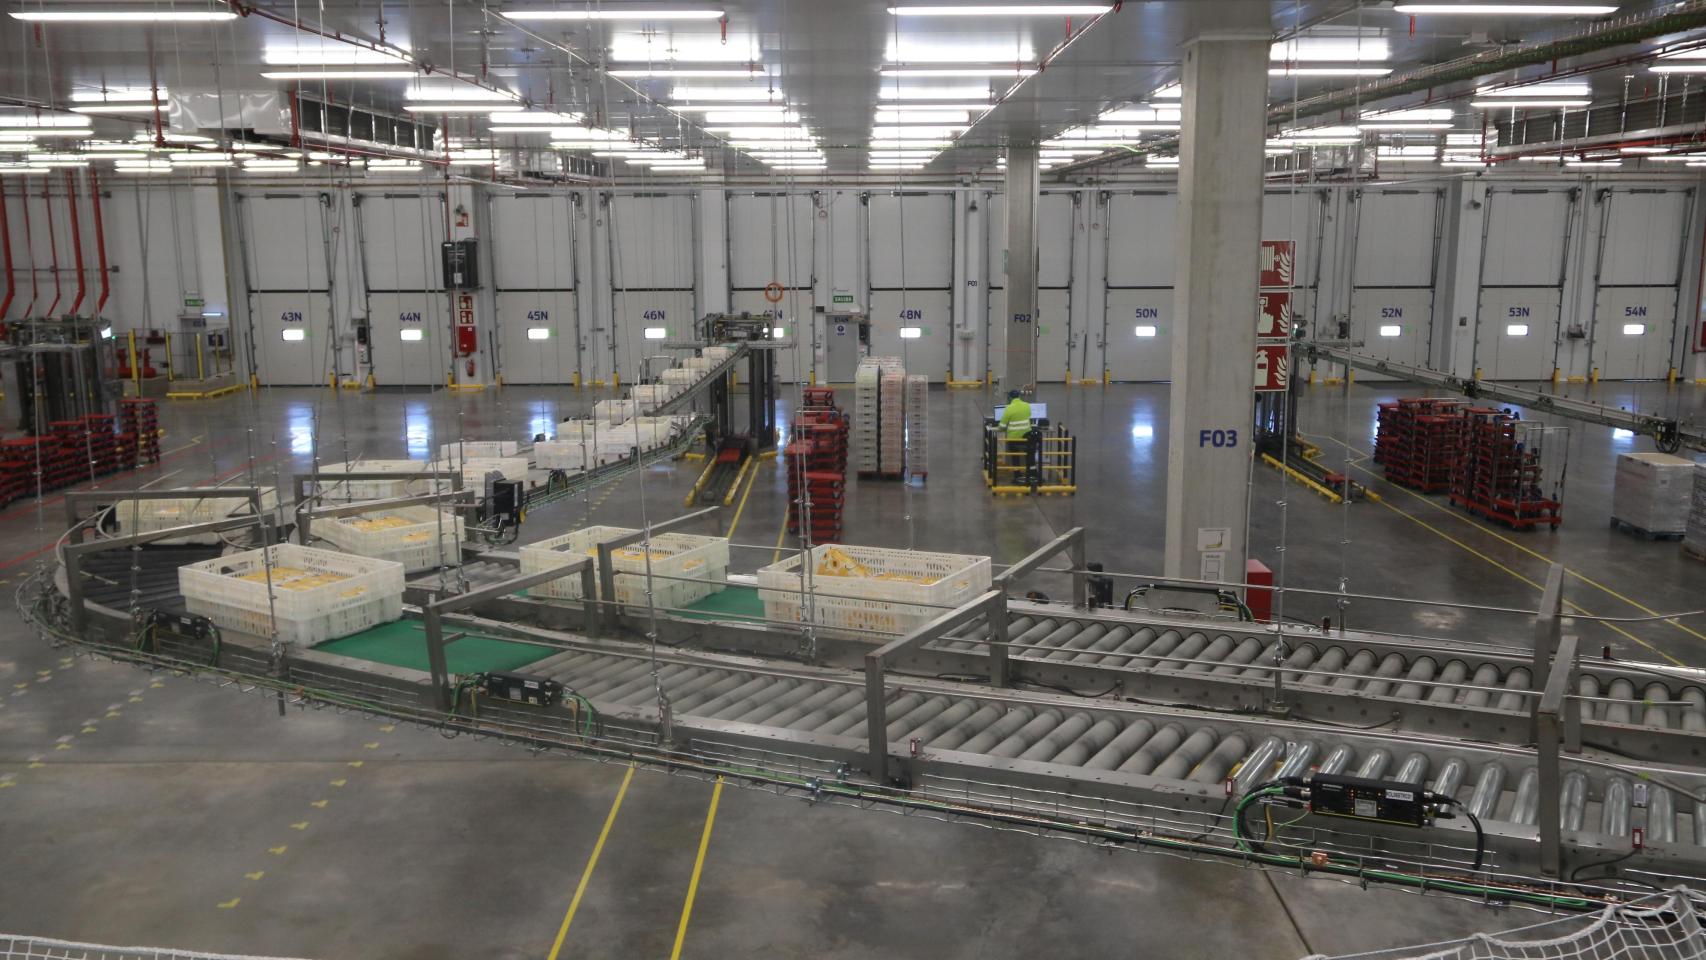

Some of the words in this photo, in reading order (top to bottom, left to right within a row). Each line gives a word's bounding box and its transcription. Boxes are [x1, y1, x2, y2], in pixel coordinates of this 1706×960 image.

[281, 311, 302, 322] 43N
[400, 312, 420, 322] 44N
[527, 310, 548, 321] 45N
[643, 310, 665, 321] 46N
[899, 309, 922, 320] 48N
[1136, 308, 1158, 318] 50N
[1381, 308, 1403, 318] 52N
[1509, 307, 1530, 317] 53N
[1625, 307, 1647, 317] 54N
[1014, 314, 1032, 323] F02
[1200, 430, 1238, 447] F03
